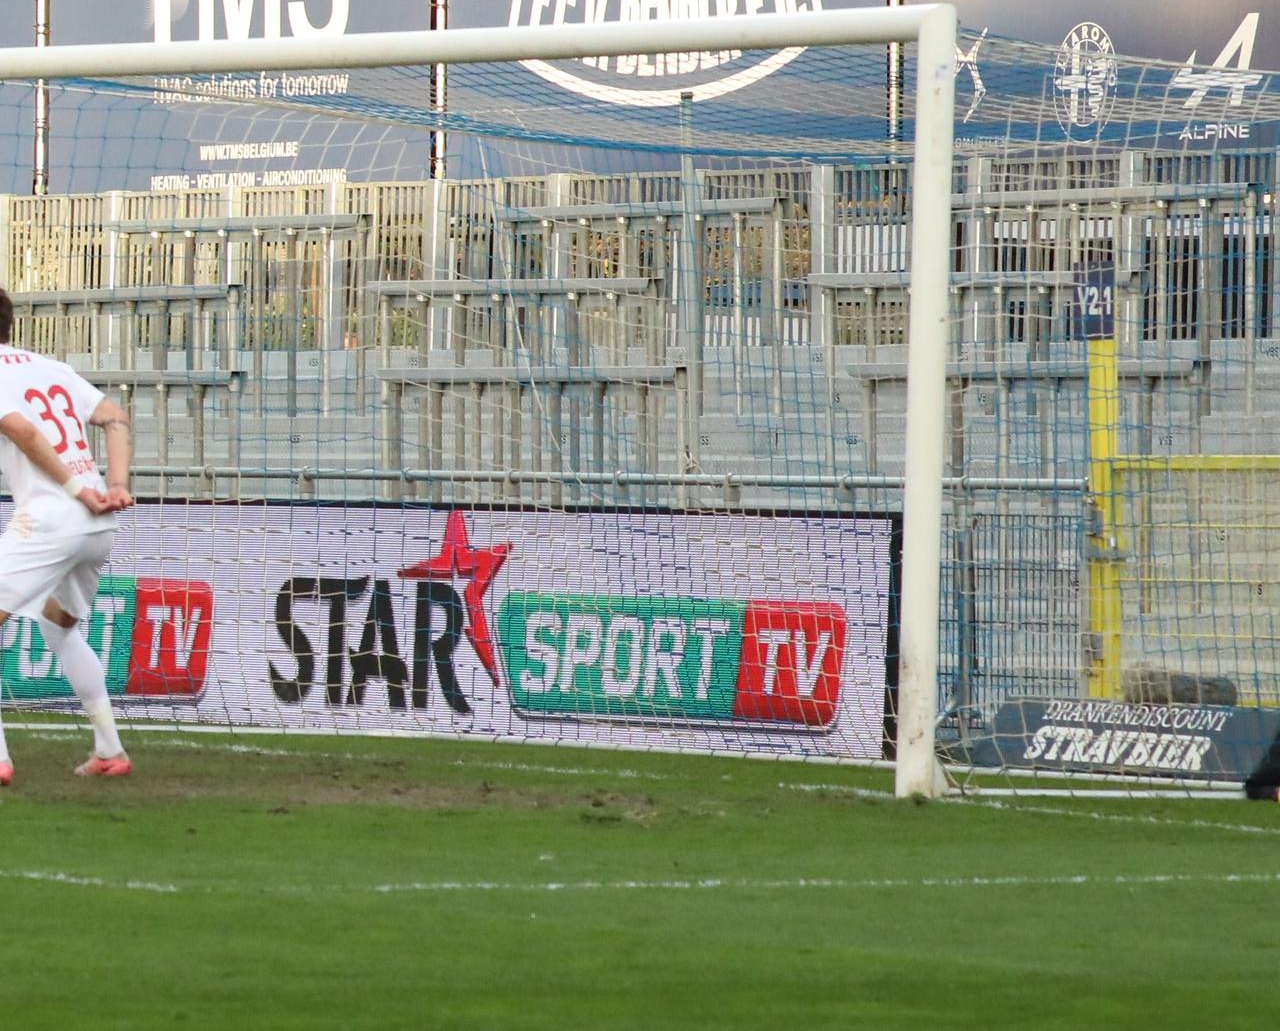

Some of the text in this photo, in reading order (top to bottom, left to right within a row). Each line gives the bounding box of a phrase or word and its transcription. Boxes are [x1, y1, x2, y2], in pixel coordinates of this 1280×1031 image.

[195, 73, 256, 102] solutions
[259, 71, 280, 98] for
[281, 73, 350, 97] tomorrow
[199, 141, 299, 161] WWW.TMSBELGIUM.BE
[1179, 123, 1251, 141] ALPINE
[151, 175, 189, 191] HEATING
[197, 172, 255, 189] VENTILATION
[262, 169, 347, 186] AIRCONDITIONING
[23, 383, 88, 455] 33
[146, 604, 202, 670] TV
[267, 576, 471, 716] STAR
[519, 612, 731, 703] SPORT
[756, 627, 834, 701] TV
[1042, 699, 1231, 732] DRANKENDISCOUNT
